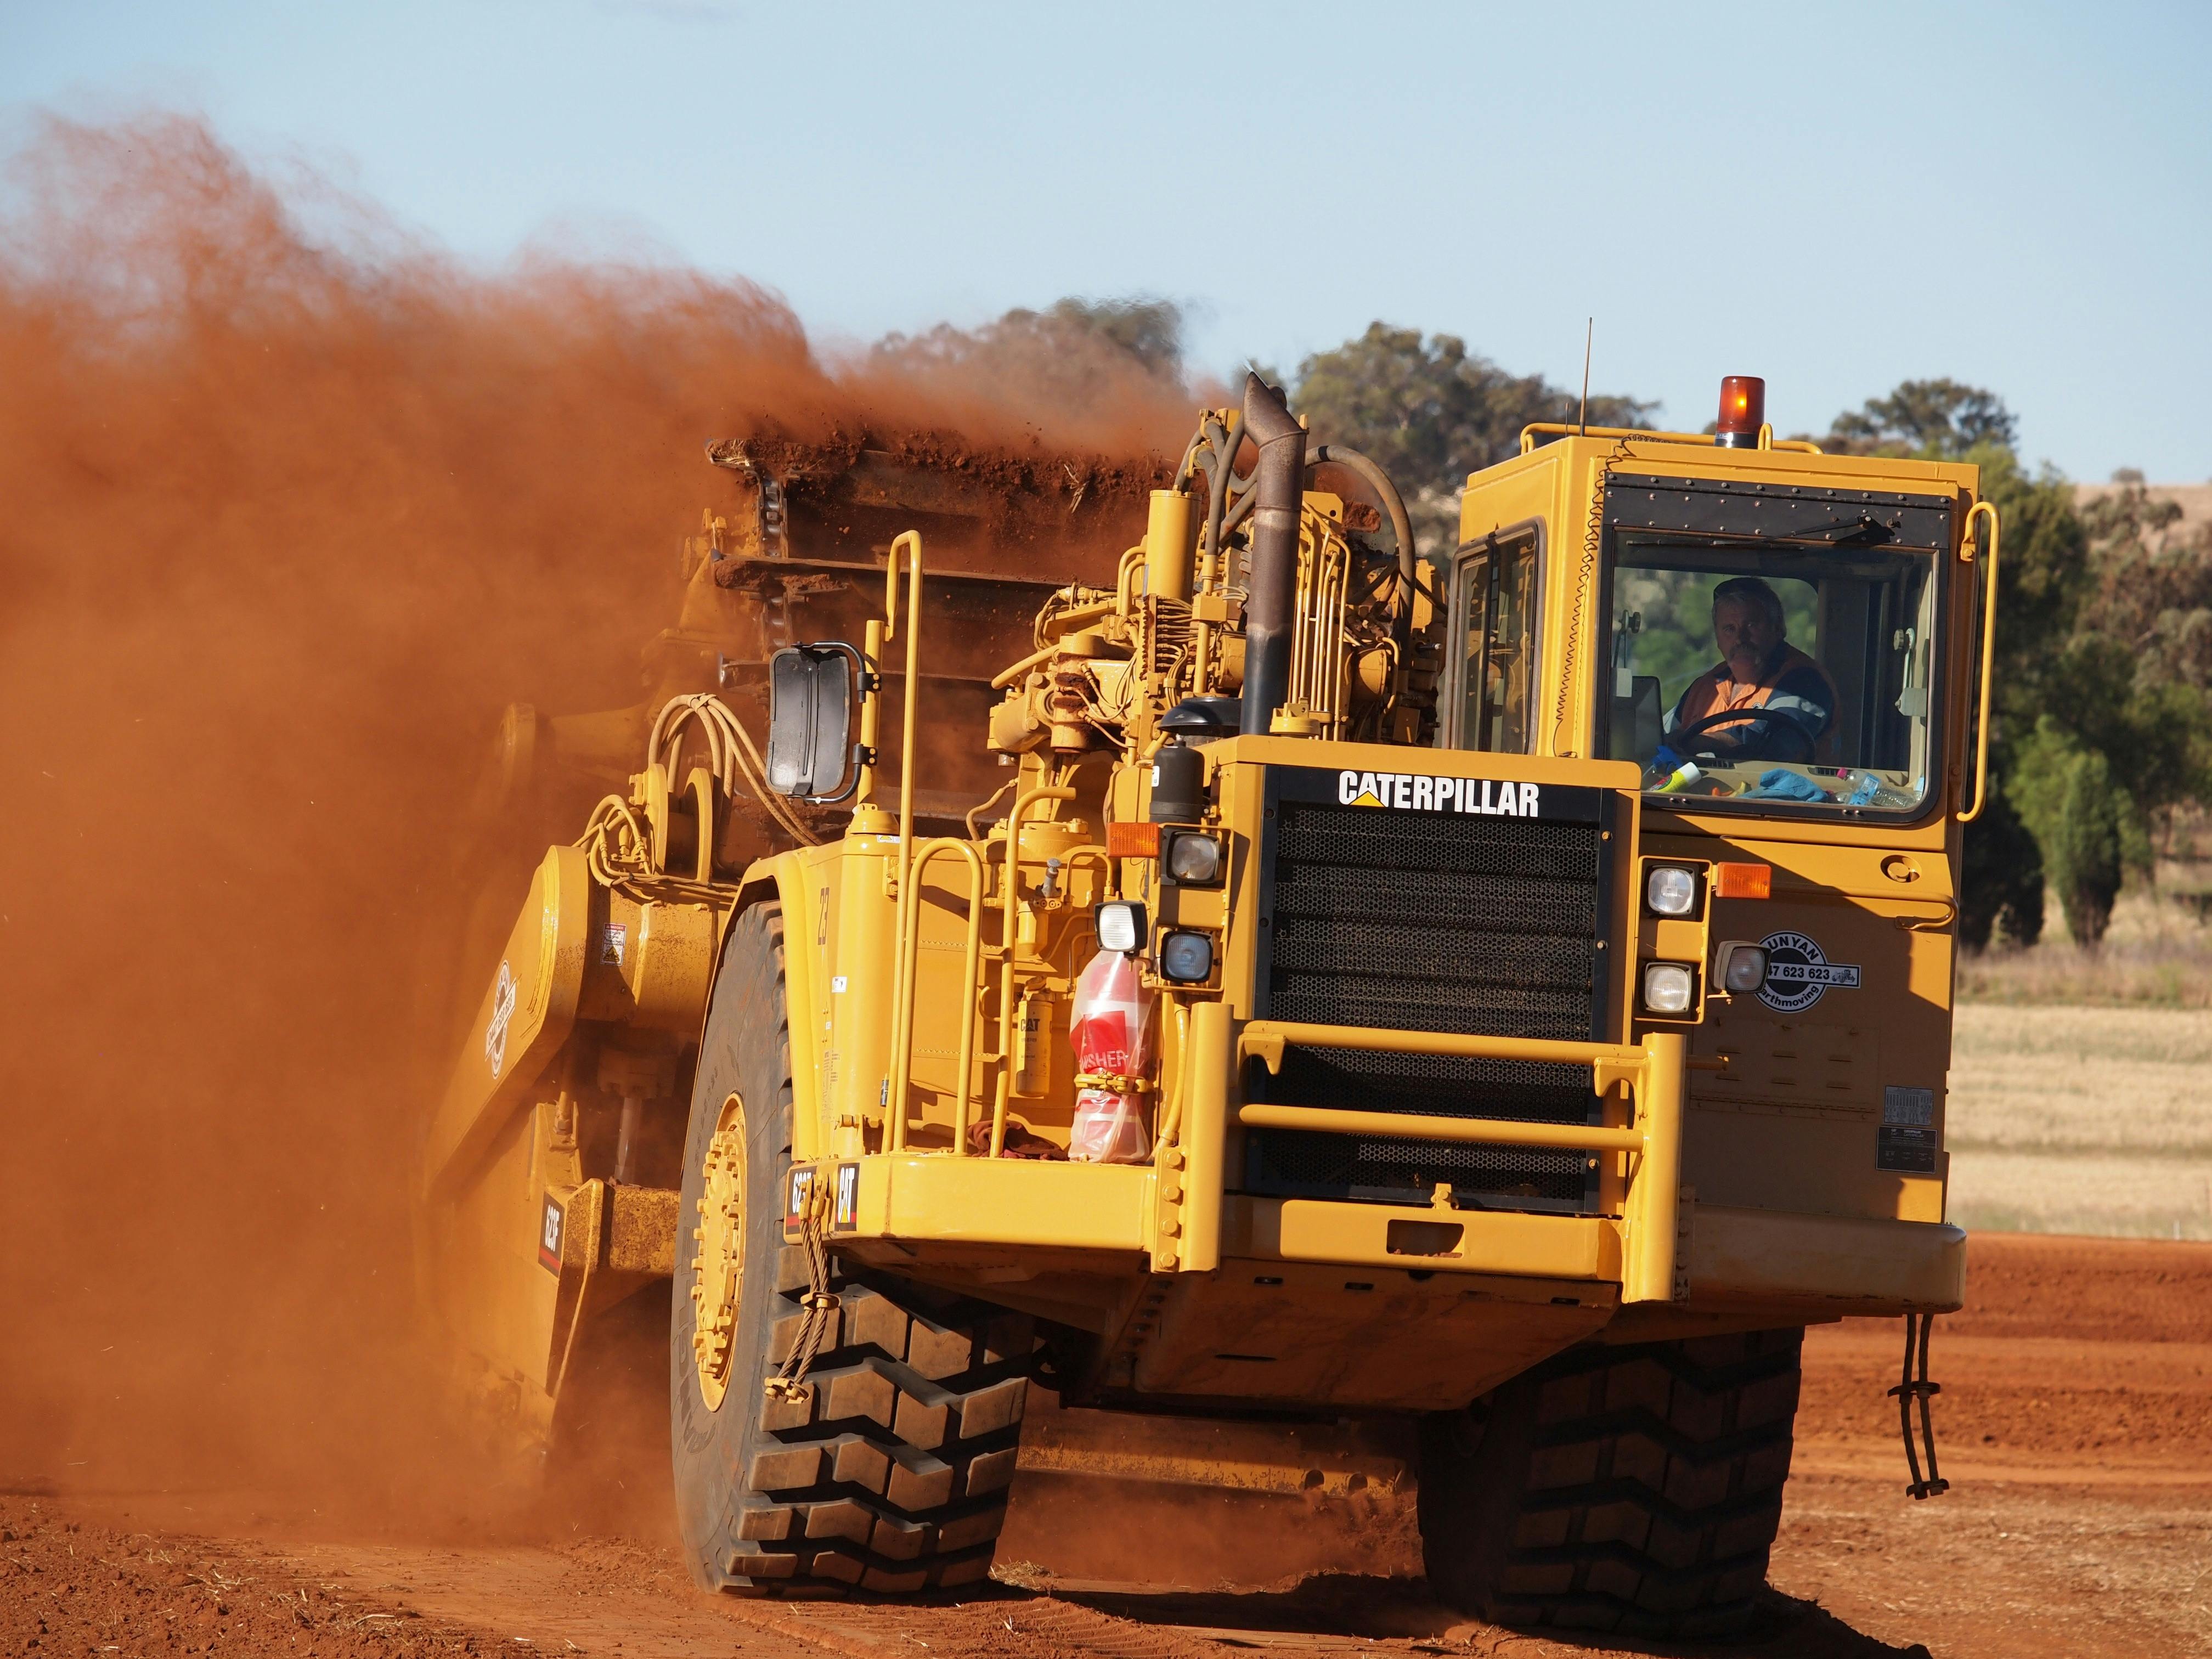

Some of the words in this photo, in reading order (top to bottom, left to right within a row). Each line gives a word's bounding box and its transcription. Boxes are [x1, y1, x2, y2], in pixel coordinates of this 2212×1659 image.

[1339, 770, 1539, 817] CATERPILLAR
[817, 887, 830, 945] 23
[1767, 936, 1819, 961] UNYAN
[1783, 966, 1804, 978] 623
[1808, 968, 1830, 980] 623
[1760, 985, 1820, 1007] arthmoving
[1020, 1018, 1040, 1032] CAT
[838, 1167, 855, 1223] CAT
[545, 1204, 560, 1252] 623F
